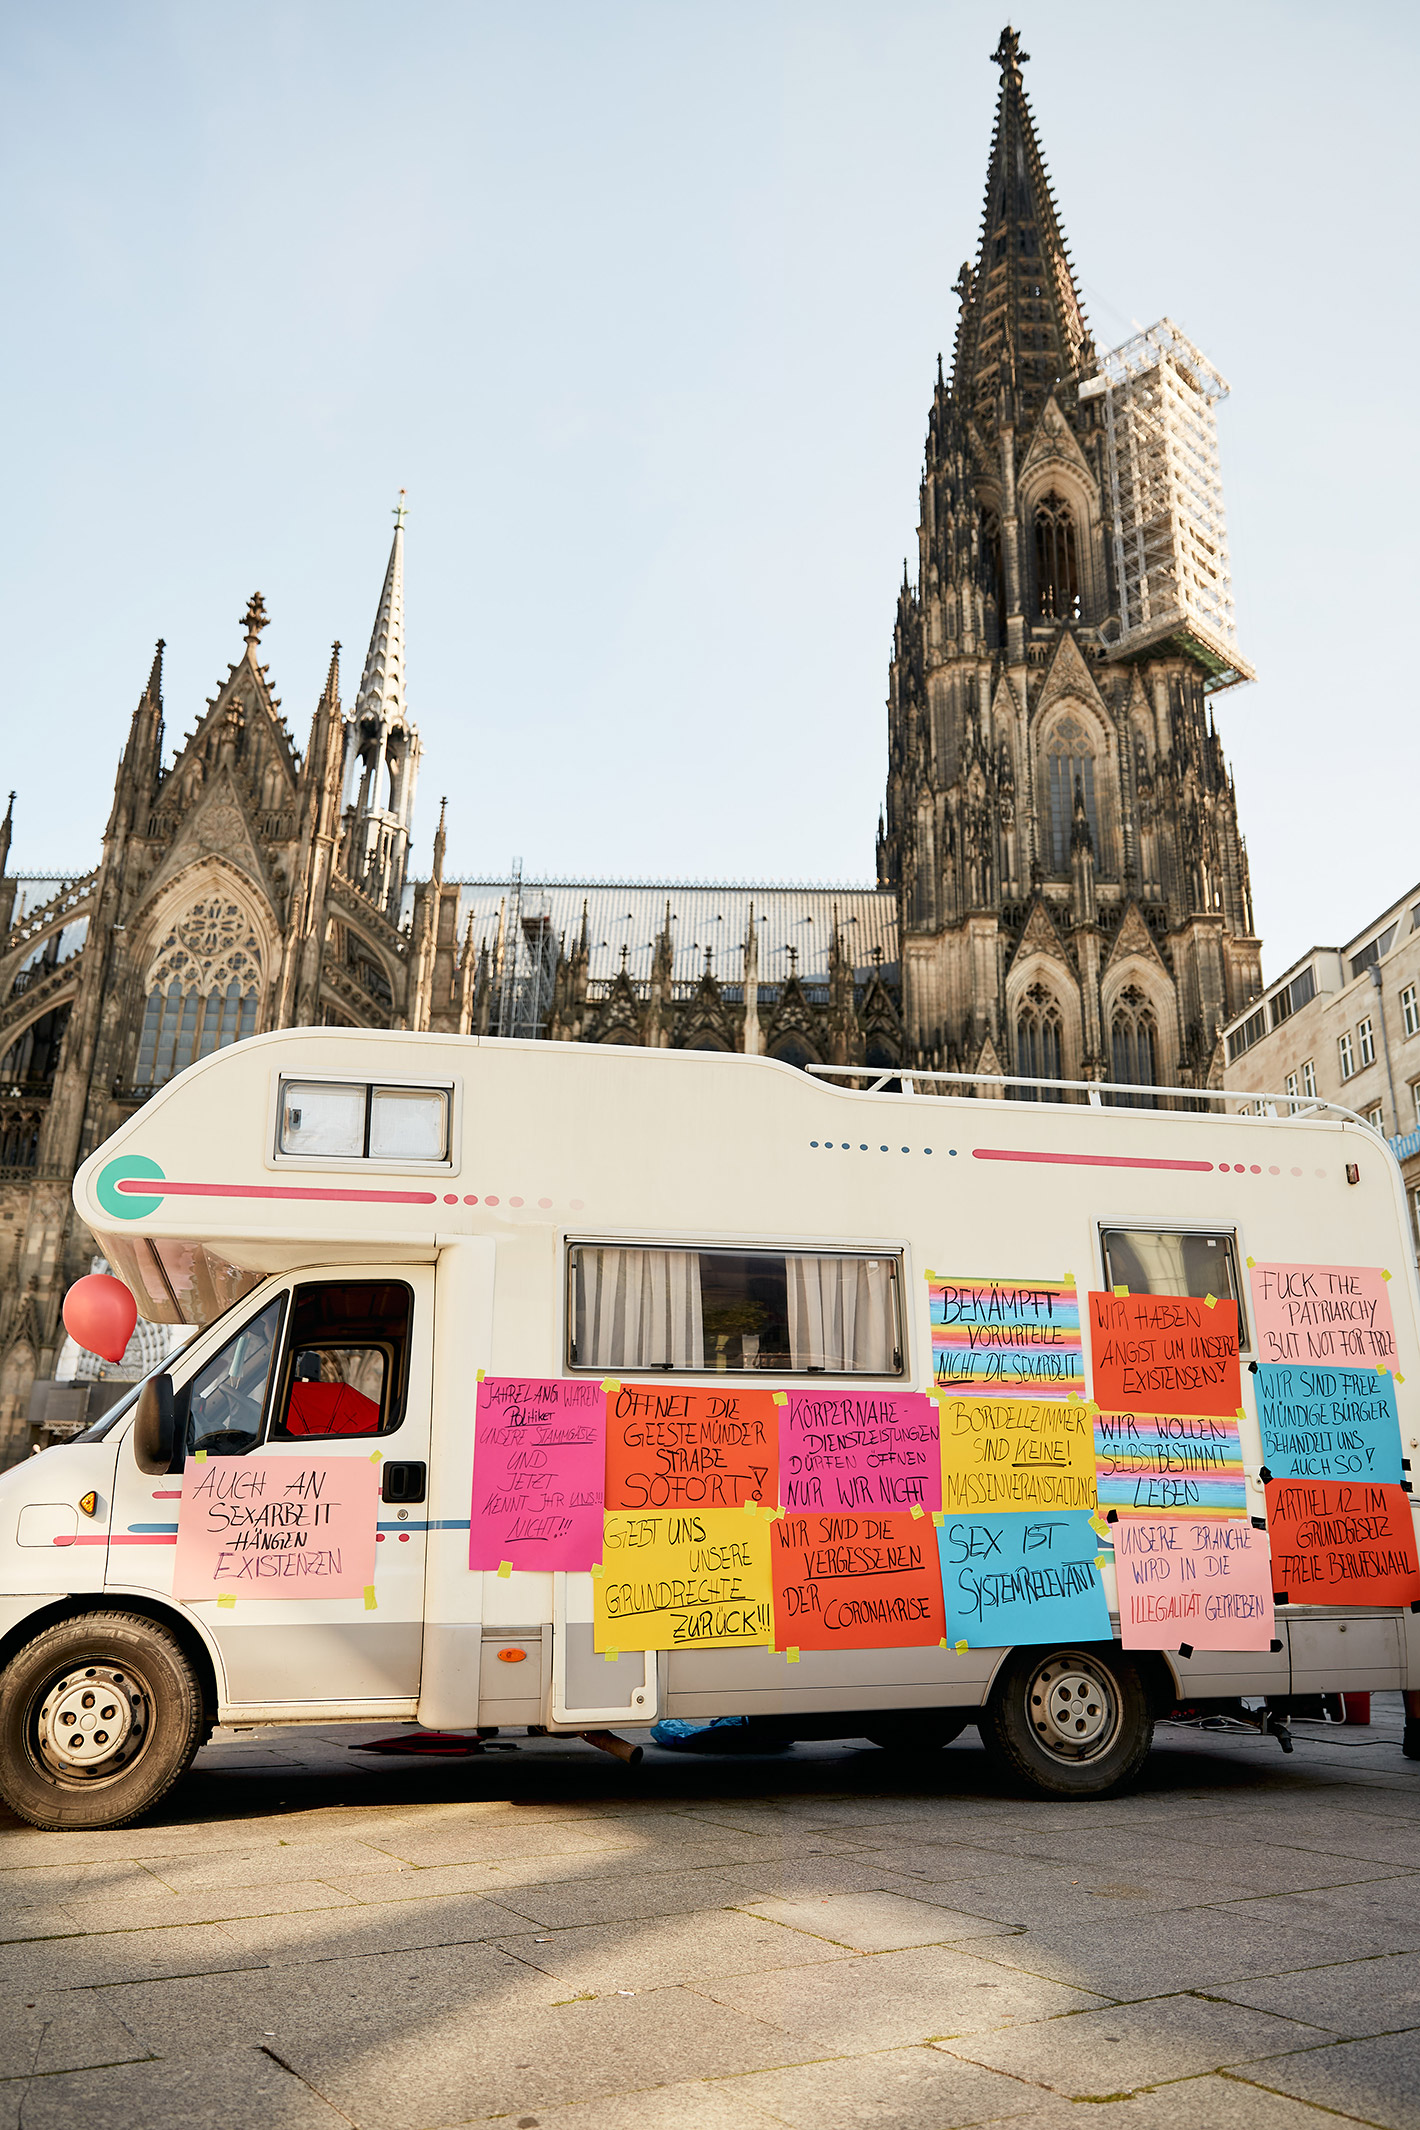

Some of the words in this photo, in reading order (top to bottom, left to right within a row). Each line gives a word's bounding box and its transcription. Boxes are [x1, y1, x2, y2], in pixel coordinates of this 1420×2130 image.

[1256, 1271, 1318, 1300] FUCK
[1320, 1273, 1362, 1295] THE
[939, 1283, 1060, 1324] BEKÄMPFT
[1096, 1299, 1129, 1330] WIR
[1134, 1304, 1200, 1329] HABEN
[1282, 1300, 1377, 1328] PATRIARCHY
[968, 1324, 1064, 1349] VORURTEILE
[1100, 1340, 1156, 1368] ANGST
[1164, 1338, 1185, 1360] UM
[1191, 1335, 1239, 1358] UNSERE
[1264, 1332, 1299, 1362] BUT
[1307, 1331, 1336, 1358] NOT
[1338, 1328, 1365, 1356] FOR
[938, 1352, 981, 1381] NICHT
[984, 1353, 1008, 1383] DIE
[1123, 1361, 1226, 1393] EXISTENSEN!
[480, 1382, 558, 1409] JAHRELANG
[1259, 1370, 1293, 1399] WIR
[1300, 1371, 1336, 1397] SIND
[615, 1388, 697, 1419] ÖFFNET
[706, 1397, 740, 1419] DIE
[949, 1402, 1086, 1435] BORDELLZIMMER
[1264, 1401, 1329, 1428] MÜNDIGE
[1330, 1398, 1390, 1425] BÜRGER
[480, 1427, 528, 1446] UNSERE
[624, 1420, 766, 1447] GEESTEMÜNDER
[803, 1425, 939, 1454] DIENSTLEISTUNGEN
[1100, 1413, 1140, 1440] WIR
[1155, 1417, 1226, 1441] WOLLEN
[973, 1438, 1010, 1463] SIND
[1102, 1443, 1230, 1476] SELBSTBESTIMMT
[1264, 1431, 1333, 1458] BEHANDELT
[1337, 1430, 1364, 1449] UNS
[507, 1450, 547, 1470] UND
[789, 1454, 856, 1474] DÜRFEN
[867, 1450, 926, 1467] ÖFFNEN
[1290, 1458, 1331, 1475] AUCH
[192, 1466, 267, 1499] AUCH
[283, 1471, 327, 1499] AN
[497, 1472, 559, 1491] JETZT
[620, 1465, 768, 1508] SOFORT!
[787, 1476, 824, 1507] NUR
[836, 1476, 874, 1508] WIR
[879, 1475, 928, 1504] NICHT
[1133, 1477, 1199, 1508] LEBEN
[482, 1493, 530, 1515] KENNT
[1336, 1488, 1361, 1512] 12
[1365, 1488, 1387, 1512] IM
[207, 1502, 342, 1532] SEXARBEIT
[603, 1518, 662, 1548] GEBT
[668, 1517, 707, 1545] UNS
[777, 1519, 809, 1548] WIR
[819, 1517, 858, 1543] SIND
[862, 1520, 894, 1539] DIE
[1296, 1516, 1393, 1548] GRUNDGESETZ
[226, 1528, 308, 1551] HÄNGEN
[949, 1524, 1003, 1563] SEX
[1023, 1523, 1069, 1554] IST
[1121, 1526, 1183, 1555] UNSERE
[1190, 1526, 1252, 1551] BRANCHE
[213, 1548, 342, 1580] EXISTENZEN
[690, 1542, 752, 1572] UNSERE
[804, 1545, 921, 1578] VERGESSENEN
[1132, 1557, 1170, 1584] WIRD
[1181, 1557, 1196, 1582] IN
[1203, 1555, 1230, 1577] DIE
[1278, 1555, 1324, 1586] FREIE
[1326, 1551, 1416, 1584] BERUFSWAHL
[605, 1578, 746, 1613] GRUNDRECHTE
[783, 1584, 821, 1616] DER
[958, 1560, 1096, 1622] SYSTEMRELEVANT
[1131, 1589, 1201, 1624] ILLEGALITÄT
[1205, 1594, 1264, 1621] GETRIEBEN
[824, 1597, 930, 1629] CORONAKRISE
